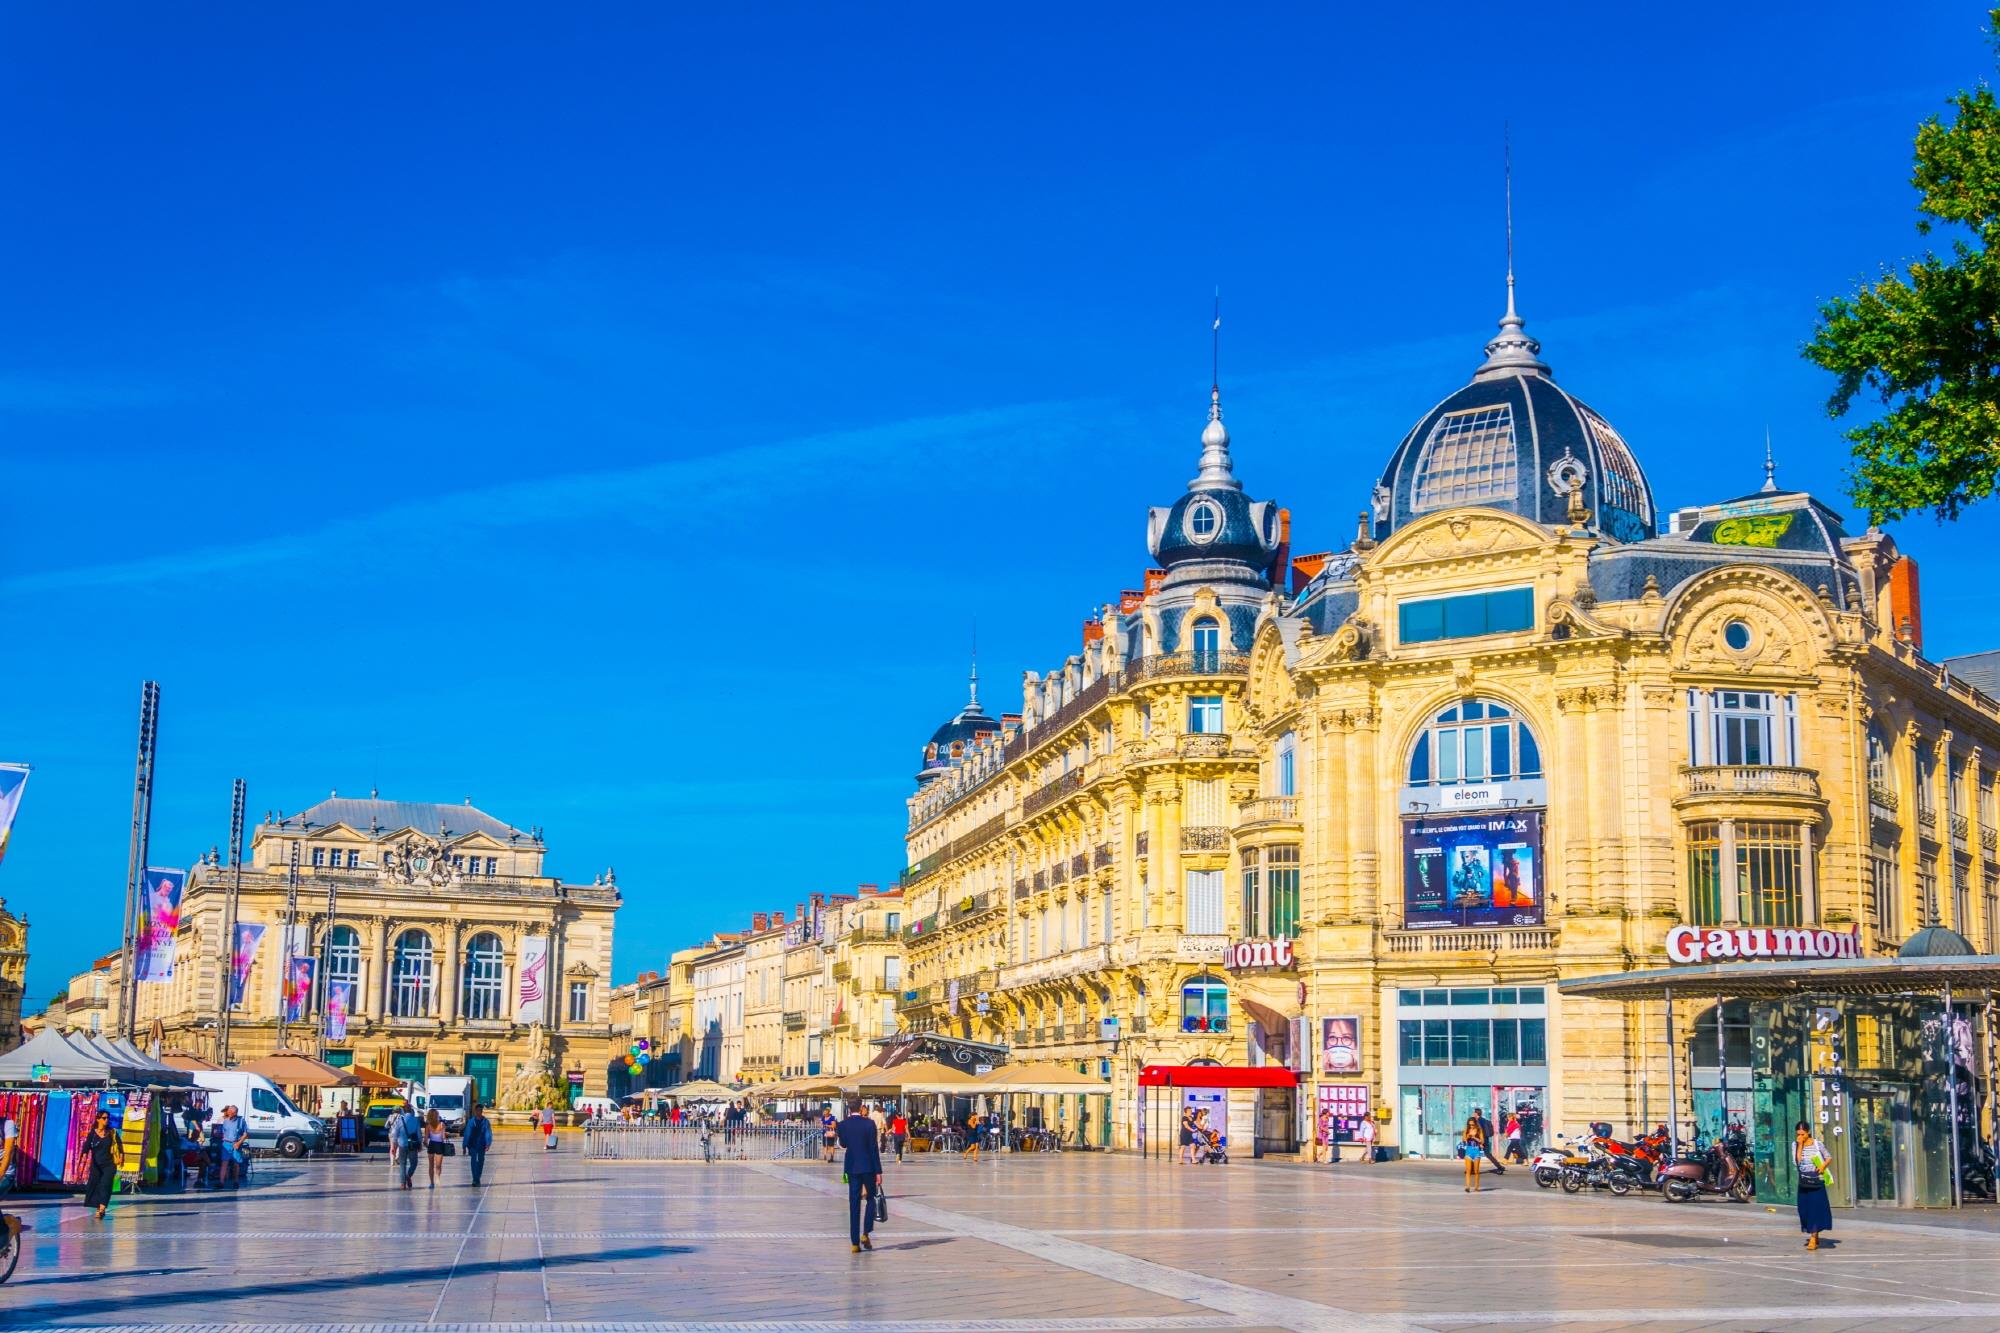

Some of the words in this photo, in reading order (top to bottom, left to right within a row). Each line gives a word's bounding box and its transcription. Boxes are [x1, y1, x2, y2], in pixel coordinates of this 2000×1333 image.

[1454, 789, 1489, 800] eleom
[1488, 819, 1528, 831] IMAX
[1665, 924, 1865, 964] Gaumont
